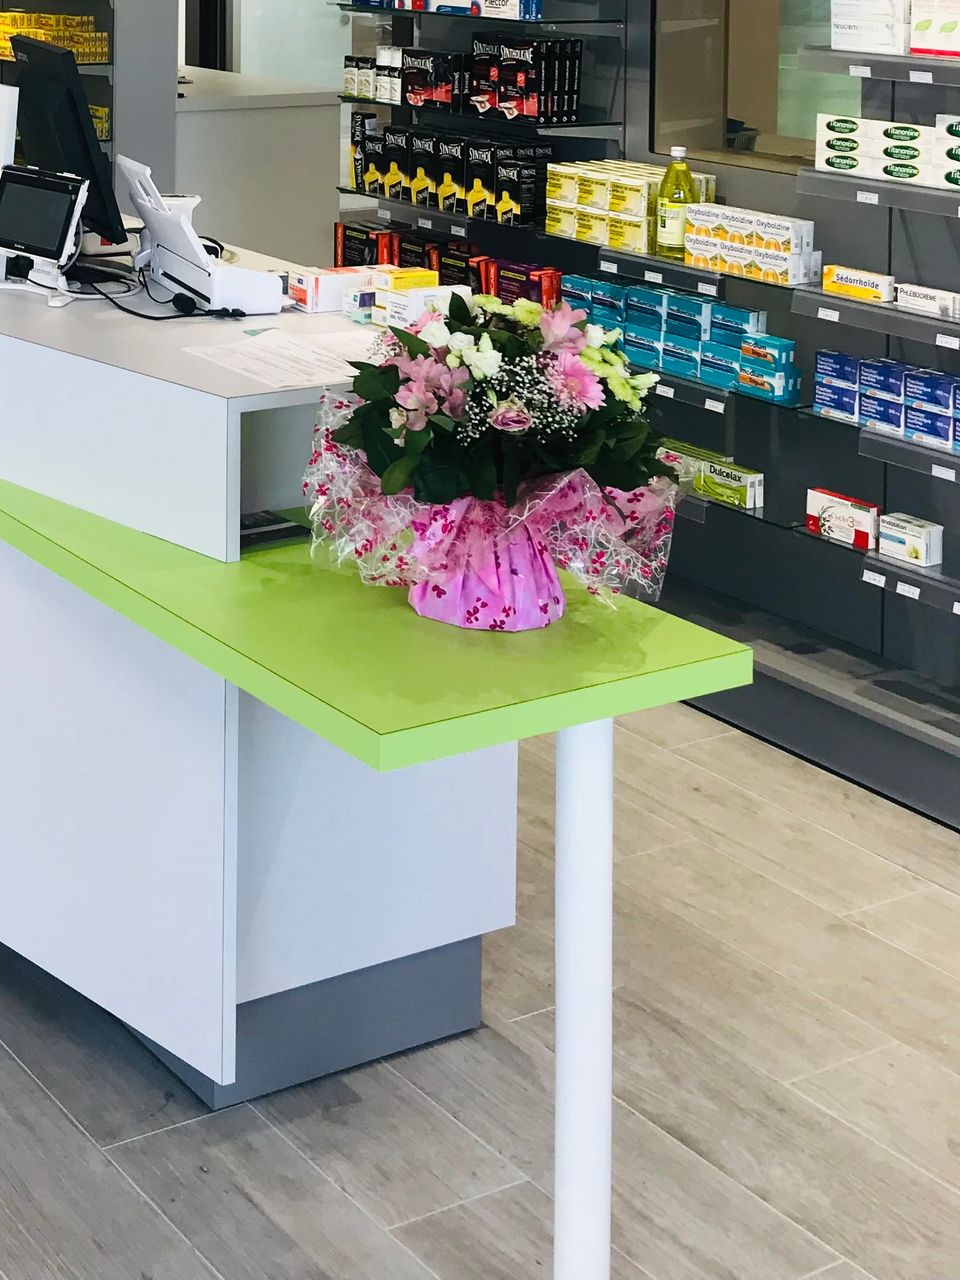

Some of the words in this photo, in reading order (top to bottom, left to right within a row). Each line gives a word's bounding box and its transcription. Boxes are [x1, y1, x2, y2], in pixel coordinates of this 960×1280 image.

[386, 132, 407, 148] SYNTHOL
[412, 137, 434, 153] SYNTHOL
[439, 142, 462, 159] SYNTHOL
[469, 148, 492, 164] SYNTHOL
[498, 166, 518, 181] SYNTHOL
[687, 206, 720, 219] Oxyboldine
[721, 212, 754, 226] Oxyboldine
[756, 219, 791, 232] Oxyboldine
[685, 236, 718, 249] Oxyboldine
[720, 242, 753, 257] Oxyboldine
[754, 249, 789, 263] Oxyboldine
[709, 464, 743, 483] Dulcolax
